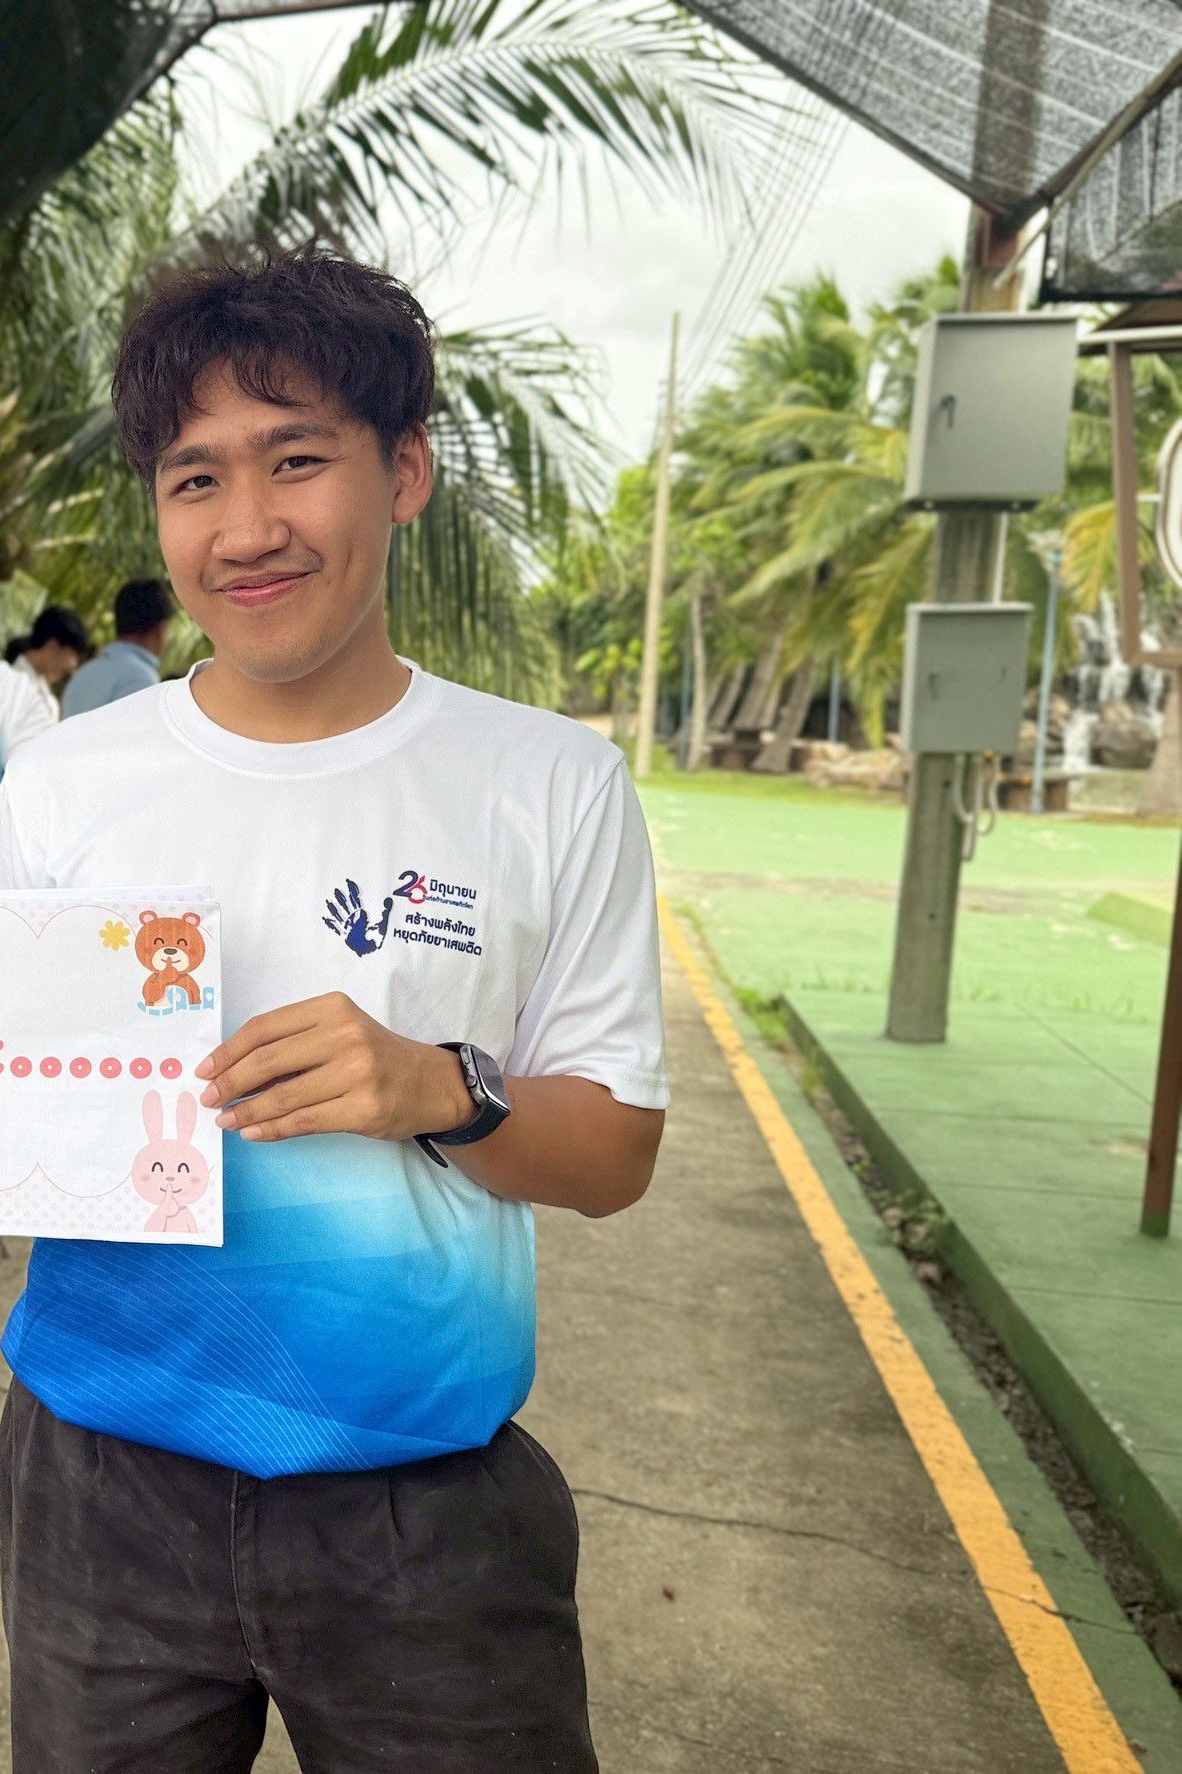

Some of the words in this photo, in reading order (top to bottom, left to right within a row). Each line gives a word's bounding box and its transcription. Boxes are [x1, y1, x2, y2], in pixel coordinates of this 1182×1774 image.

[393, 870, 428, 904] 26
[429, 878, 477, 900] มิถุนายน
[405, 912, 476, 937] สร้างพลังไทย
[393, 928, 482, 956] หยุดภัยยาเสพติด
